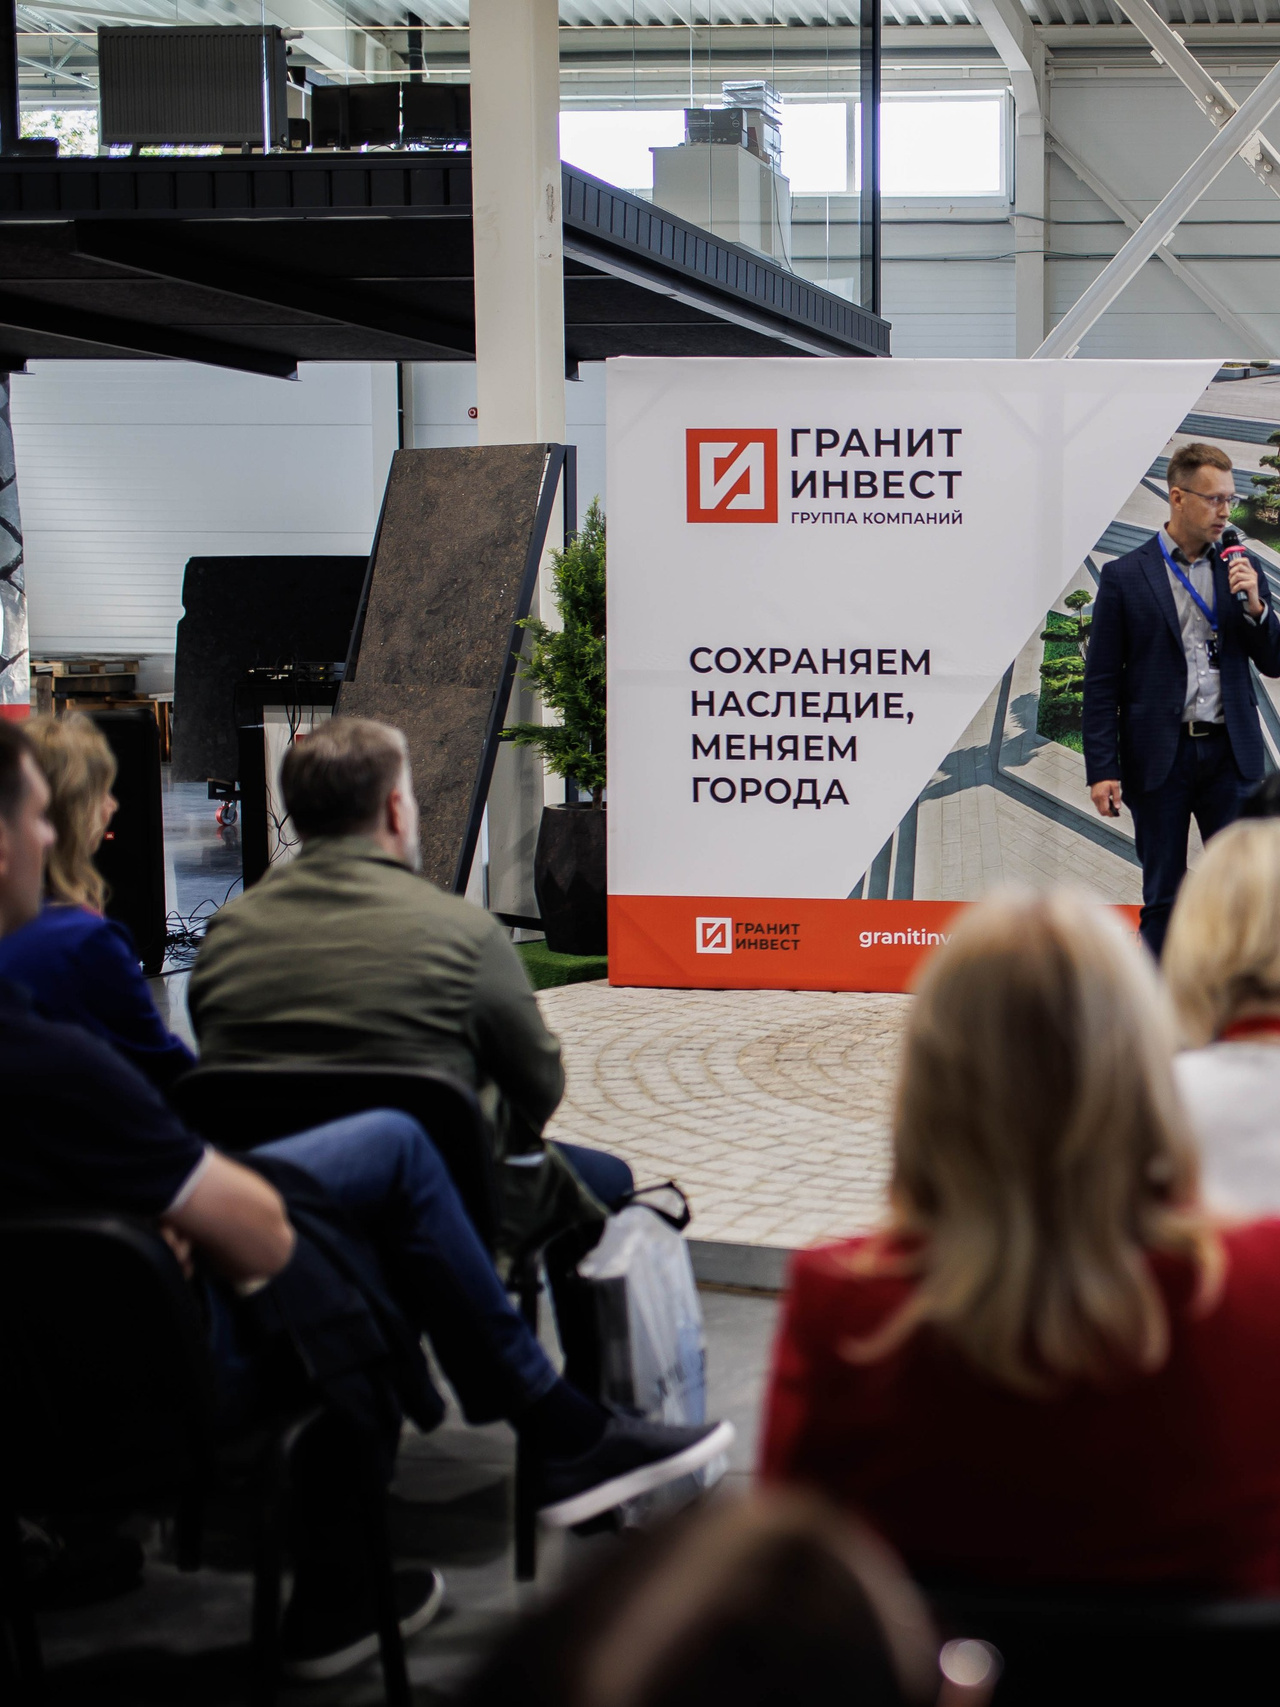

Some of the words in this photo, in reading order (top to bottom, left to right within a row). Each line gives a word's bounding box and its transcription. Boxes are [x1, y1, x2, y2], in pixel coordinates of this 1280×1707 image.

[790, 428, 963, 458] ГРАНИТ
[790, 470, 963, 500] ИНВЕСТ
[791, 511, 858, 525] ГРУППА
[863, 509, 963, 525] КОМПАНИЙ
[689, 646, 931, 676] СОХРАНЯЕМ
[690, 690, 915, 725] НАСЛЕДИЕ,
[691, 733, 858, 762] МЕНЯЕМ
[692, 776, 850, 810] ГОРОДА
[735, 922, 801, 935] ГРАНИТ
[858, 927, 952, 948] granitinv
[735, 938, 801, 951] ИНВЕСТ
